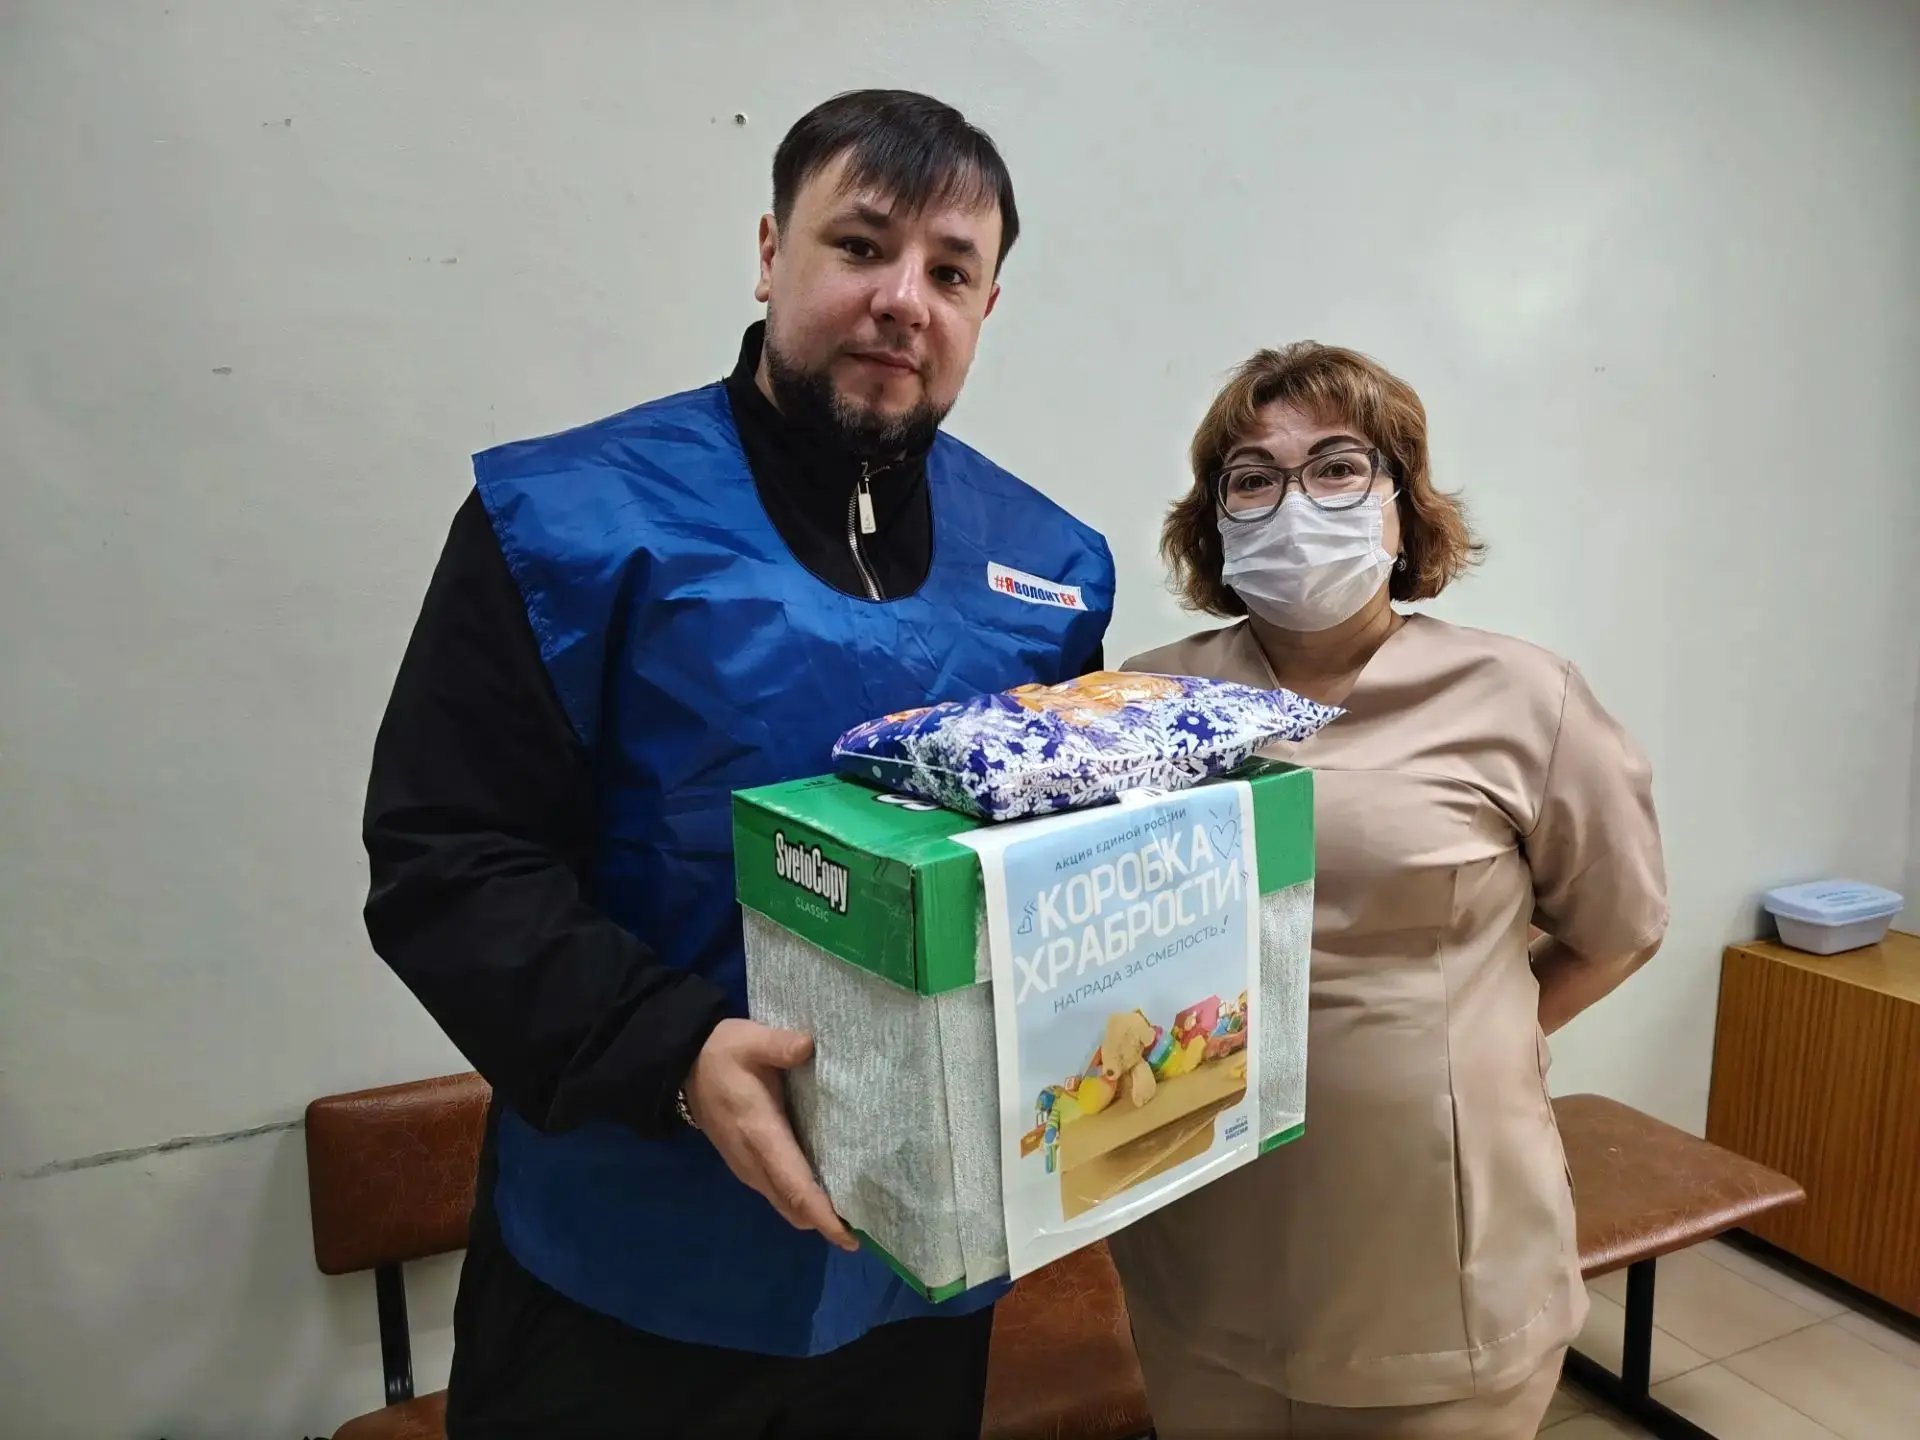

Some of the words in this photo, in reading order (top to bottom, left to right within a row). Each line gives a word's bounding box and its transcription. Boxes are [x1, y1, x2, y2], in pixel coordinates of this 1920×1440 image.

[994, 574, 1077, 607] #ЯВОЛОНТЕР
[1055, 848, 1093, 871] АКЦИЯ
[1096, 826, 1141, 854] ЕДИНОЙ
[775, 832, 848, 912] SvetoCopy
[795, 896, 829, 923] CLASSIC
[1053, 971, 1123, 1013] НАГРАДА
[1124, 960, 1144, 979] ЗА
